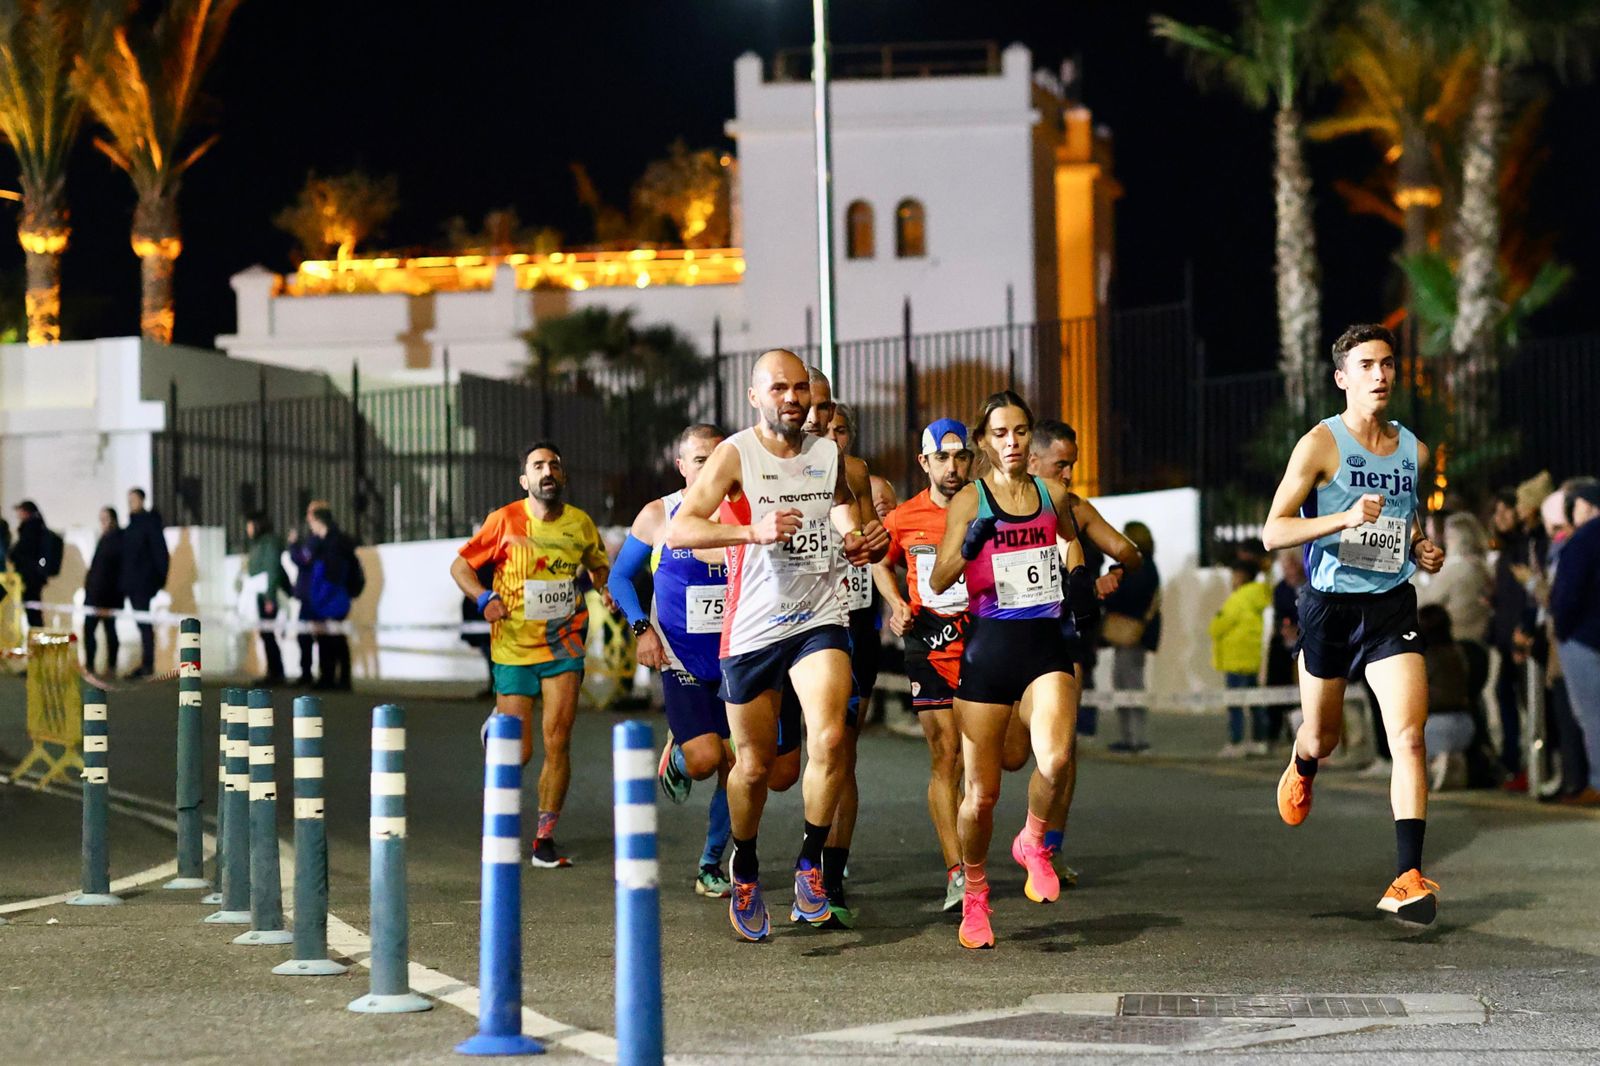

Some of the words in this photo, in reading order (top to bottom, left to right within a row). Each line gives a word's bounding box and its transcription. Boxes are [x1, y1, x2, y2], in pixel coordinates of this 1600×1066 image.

[1350, 468, 1412, 496] nerja
[783, 533, 819, 554] 425
[994, 527, 1047, 548] POZIK
[1360, 531, 1394, 550] 1090
[1040, 550, 1048, 560] M
[1027, 565, 1040, 584] 6
[702, 599, 726, 615] 75
